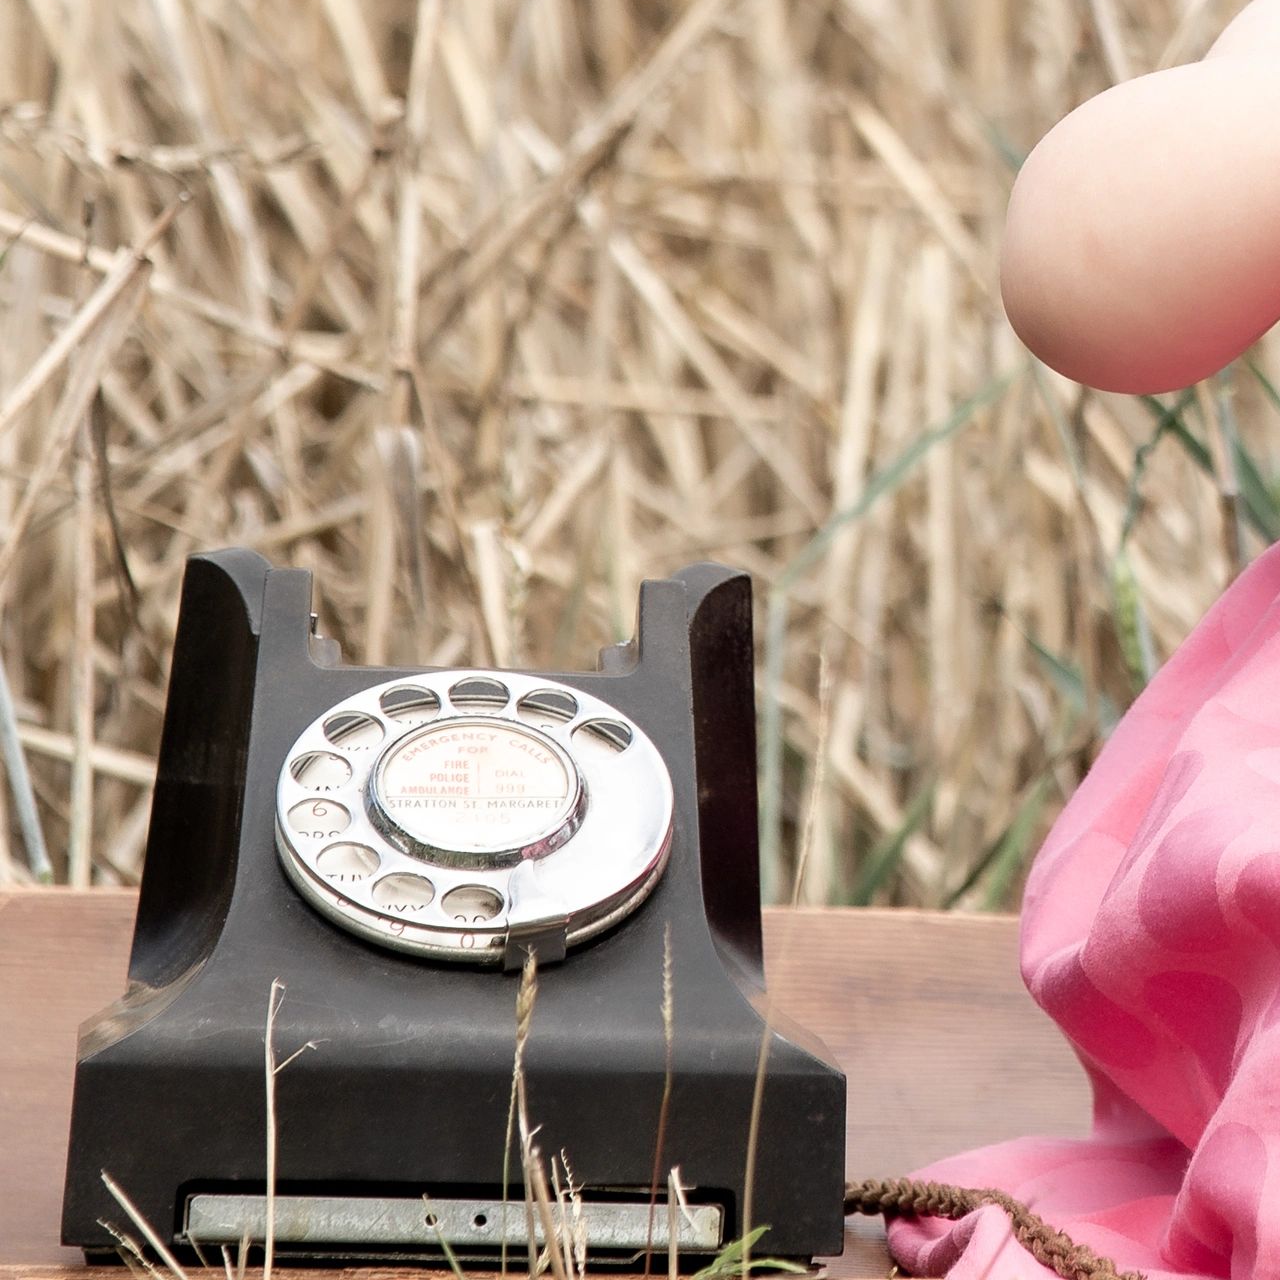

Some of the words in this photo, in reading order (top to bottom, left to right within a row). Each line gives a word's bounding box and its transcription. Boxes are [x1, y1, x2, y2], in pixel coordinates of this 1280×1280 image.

[403, 733, 498, 763] EMERGENCY
[509, 739, 552, 765] CALLS
[458, 746, 489, 754] FOR
[444, 760, 470, 769] FIRE
[429, 773, 470, 783] POLICE
[495, 770, 527, 778] DIAL
[400, 786, 470, 795] AMBULANCE
[495, 784, 526, 793] 999
[390, 800, 457, 809] STRATTON
[312, 802, 327, 817] 6
